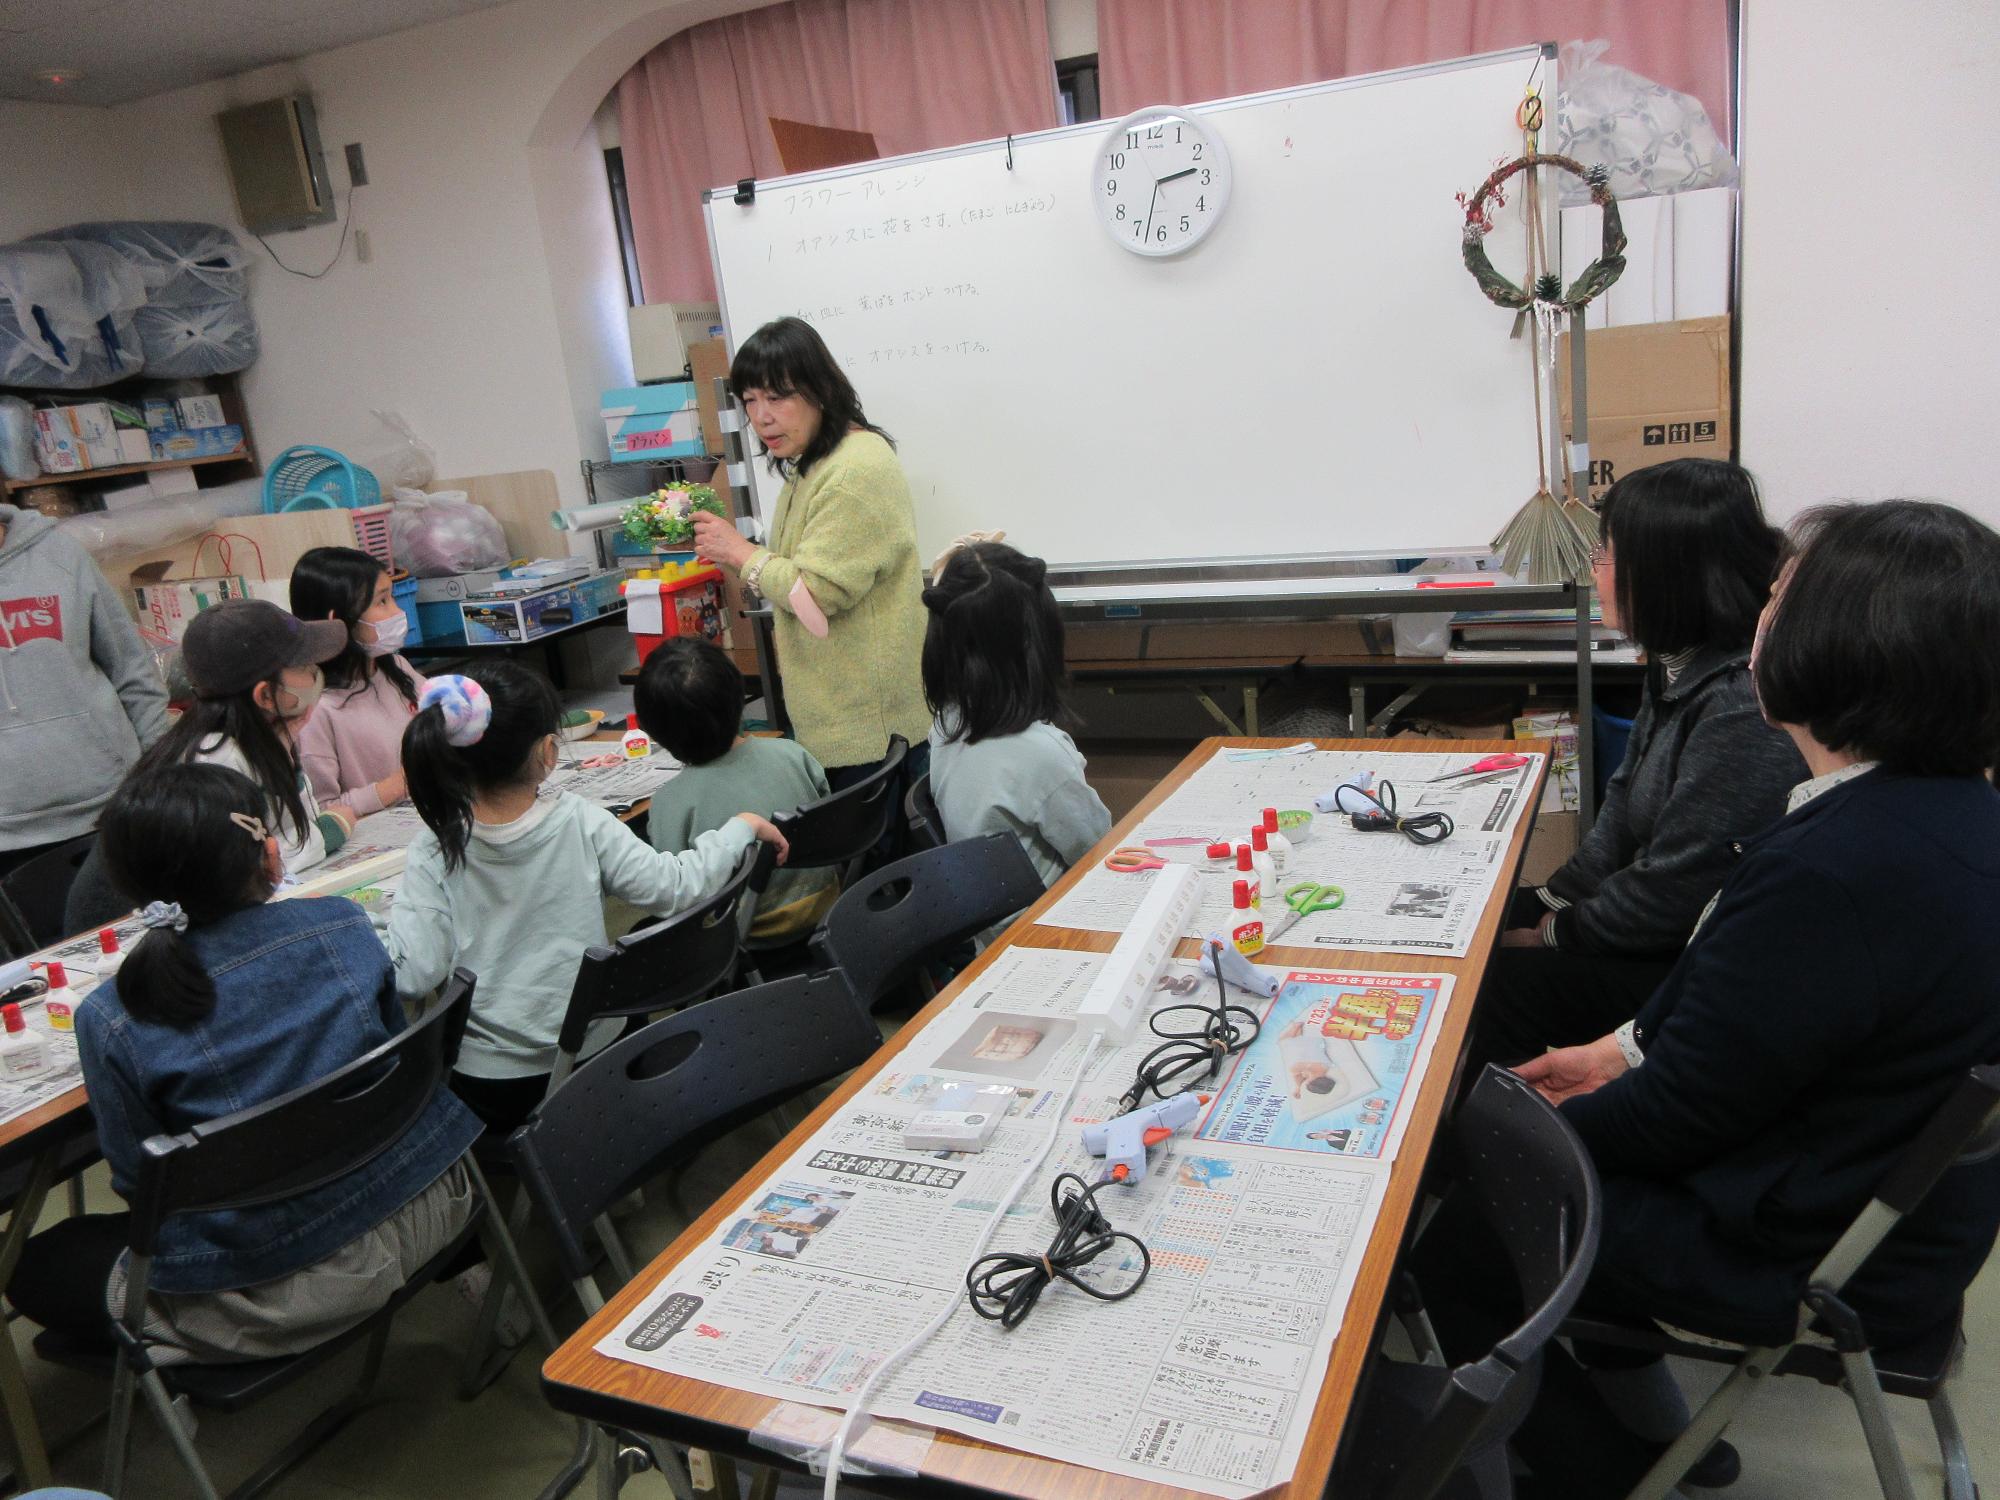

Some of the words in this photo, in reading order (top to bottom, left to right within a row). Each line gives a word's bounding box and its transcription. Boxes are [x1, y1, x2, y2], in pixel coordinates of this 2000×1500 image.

[1126, 132, 1139, 149] 11
[1146, 126, 1163, 140] 12
[1176, 127, 1182, 143] 1
[1192, 144, 1202, 160] 2
[1110, 153, 1125, 170] 10
[1201, 169, 1210, 185] 3
[1107, 180, 1116, 196] 9
[1195, 195, 1205, 211] 4
[1116, 204, 1125, 220] 8
[1133, 220, 1142, 236] 7
[1180, 216, 1189, 232] 5
[1157, 226, 1166, 241] 6
